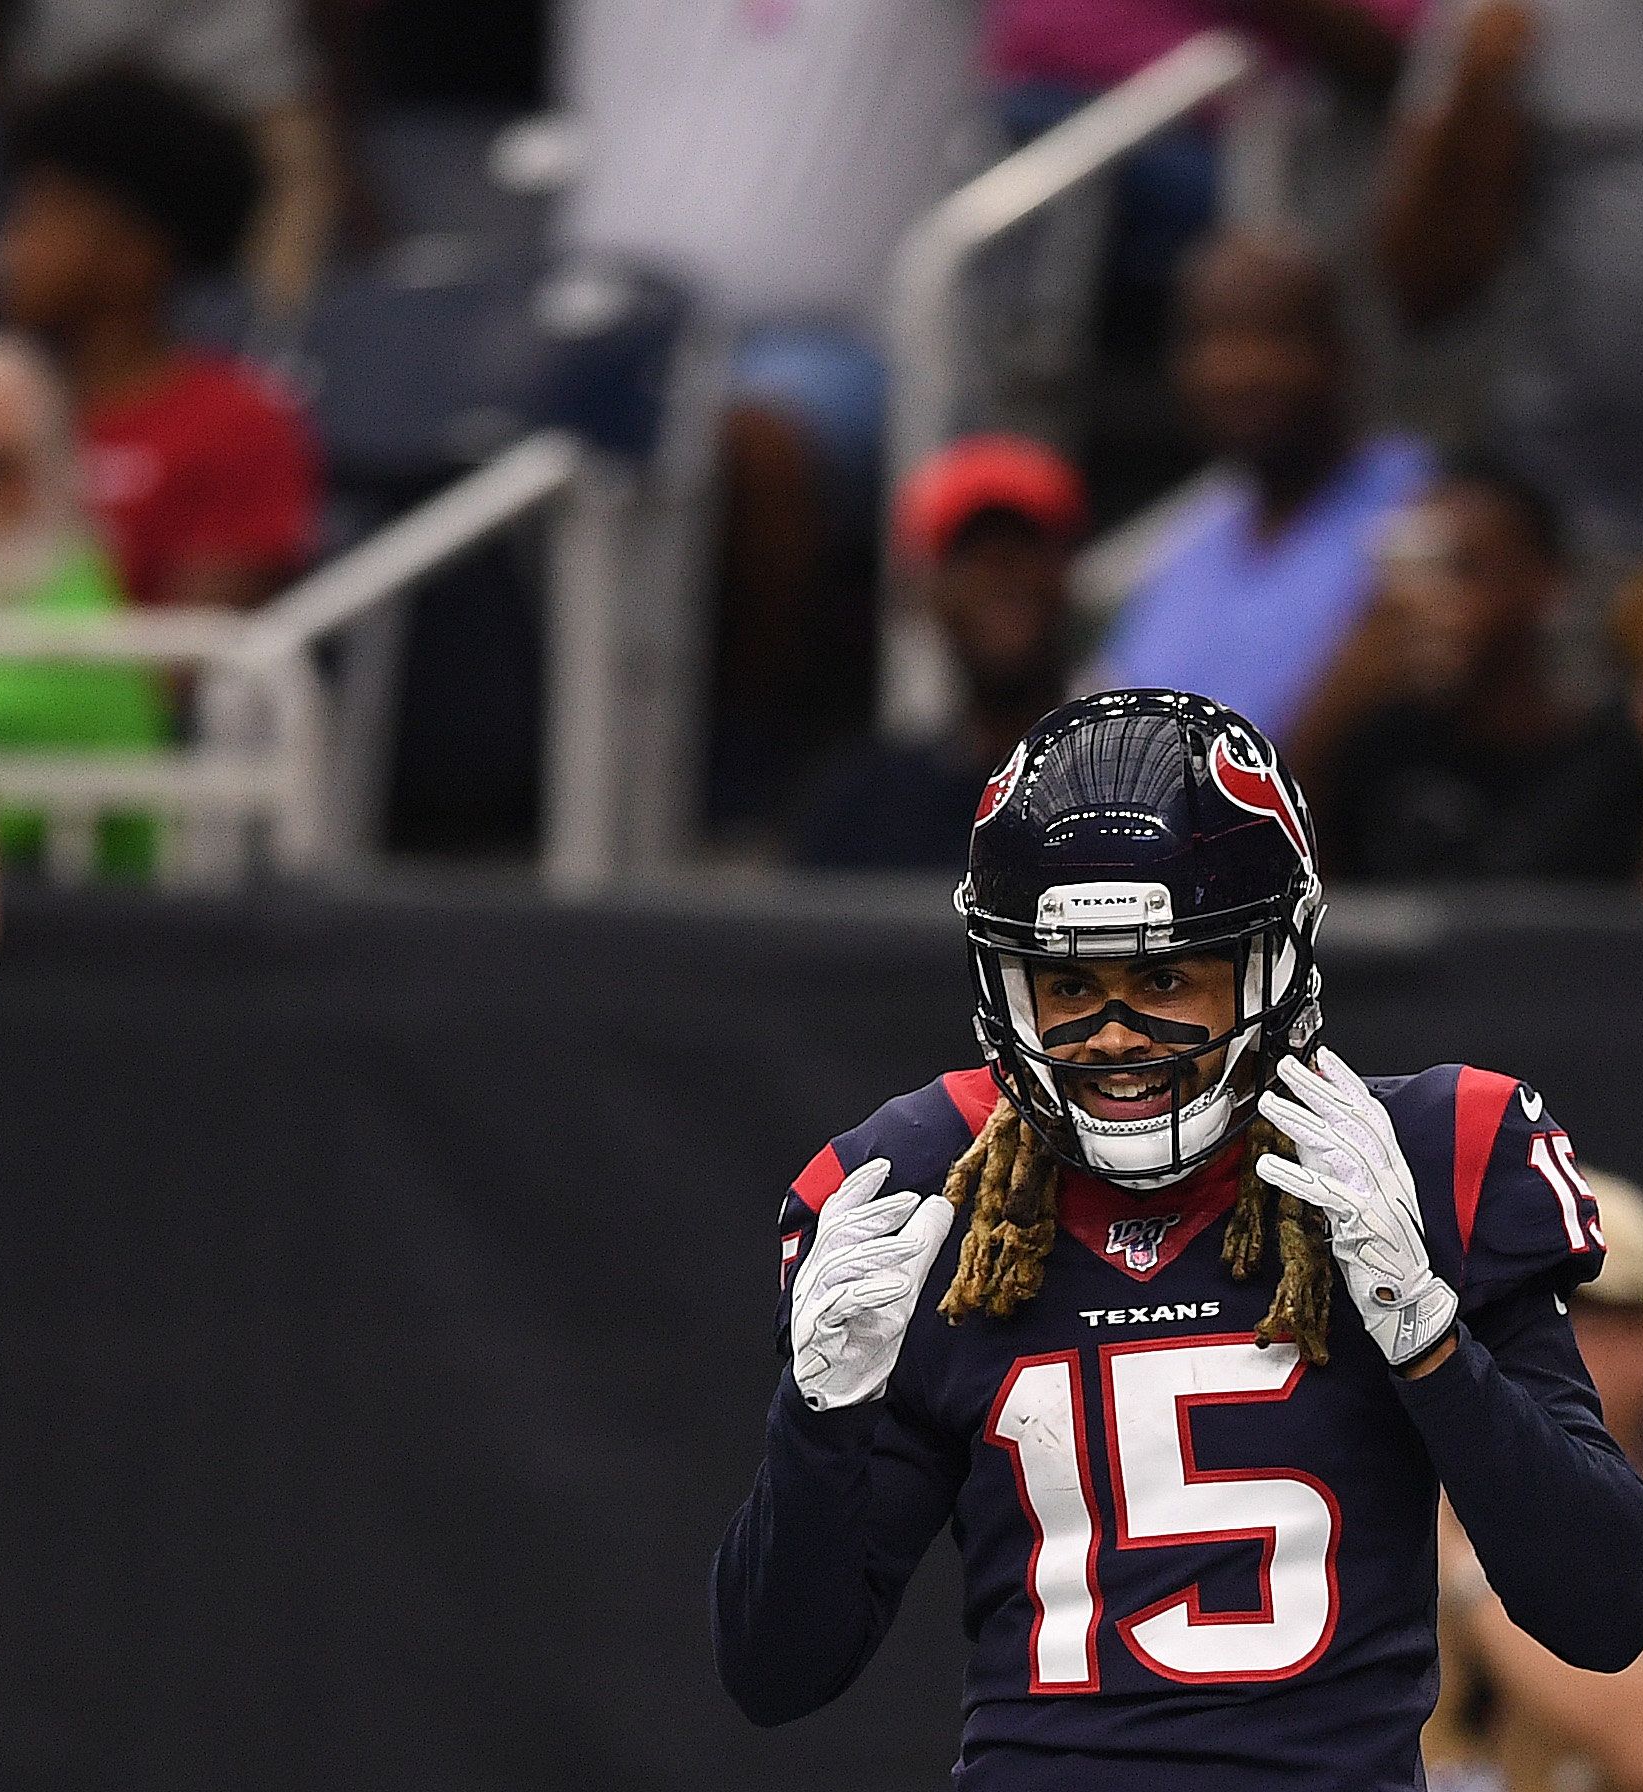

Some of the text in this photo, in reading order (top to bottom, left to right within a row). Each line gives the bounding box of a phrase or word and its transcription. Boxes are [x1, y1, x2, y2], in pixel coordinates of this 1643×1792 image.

[1071, 896, 1138, 907] TEXANS
[1079, 1301, 1221, 1327] TEXANS
[1401, 1320, 1414, 1340] XL
[983, 1330, 1342, 1694] 15
